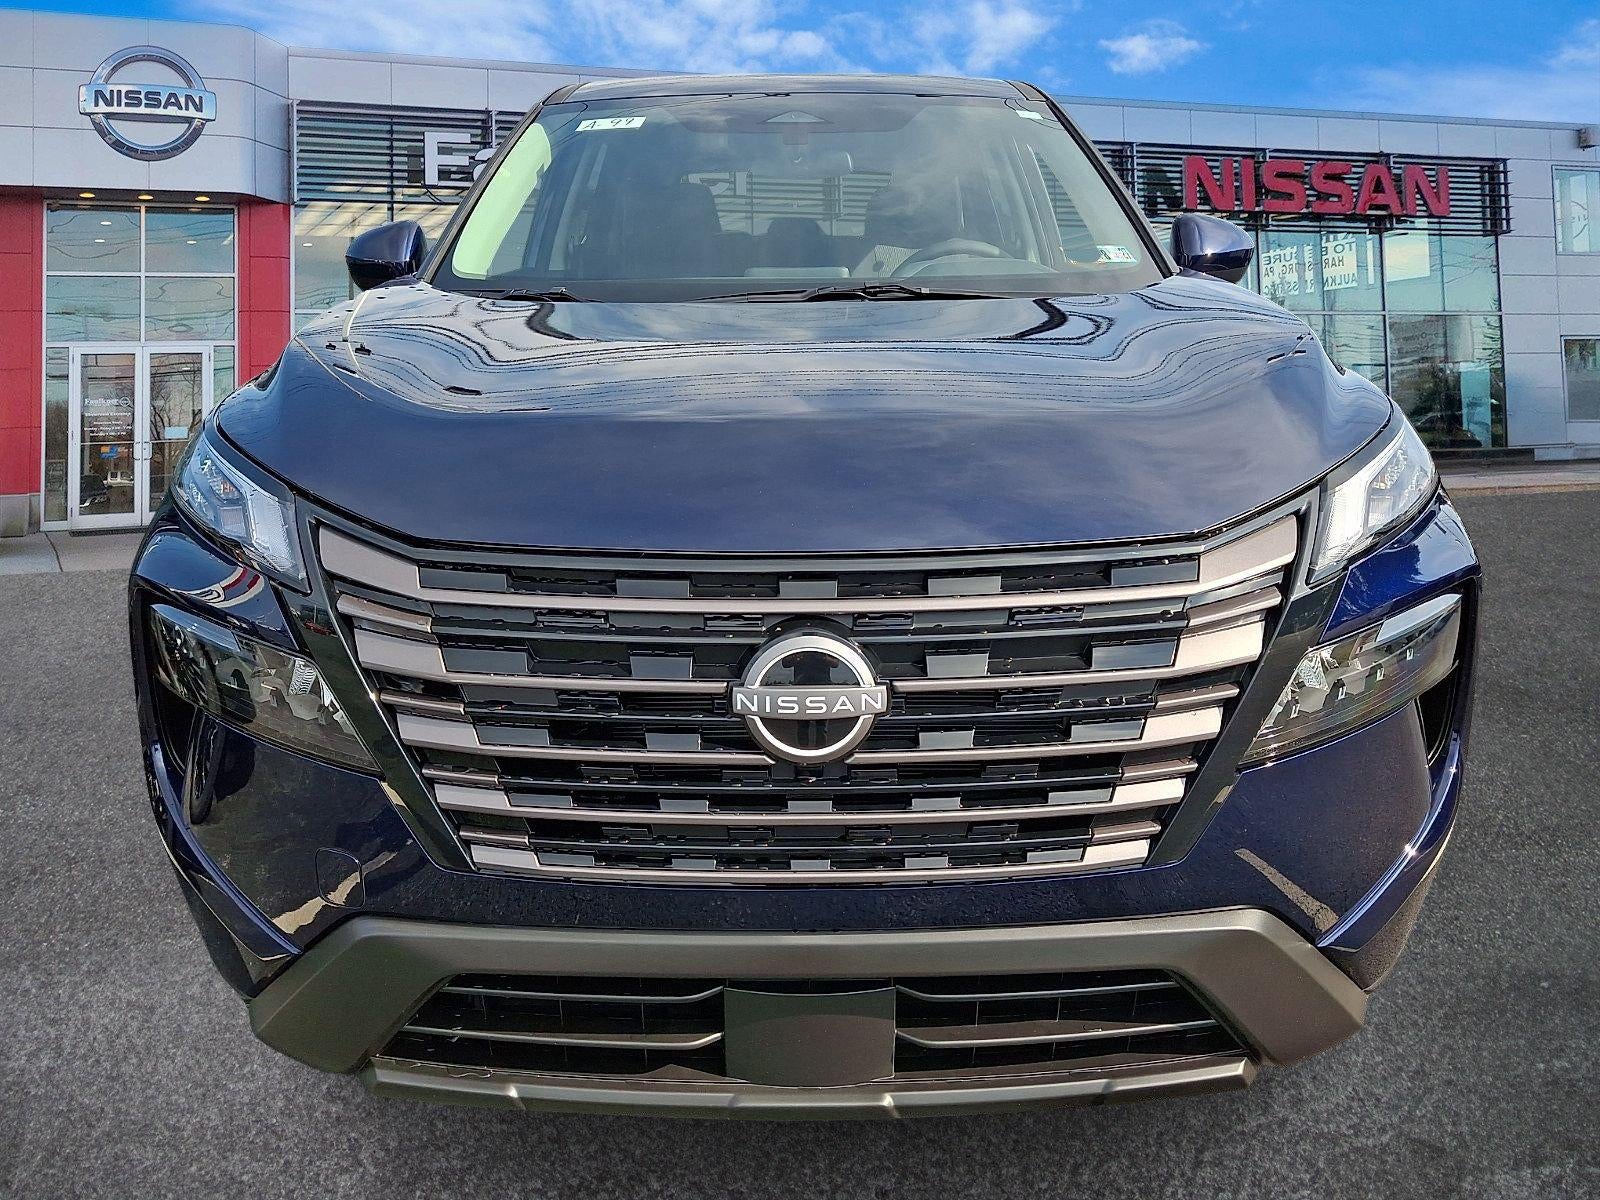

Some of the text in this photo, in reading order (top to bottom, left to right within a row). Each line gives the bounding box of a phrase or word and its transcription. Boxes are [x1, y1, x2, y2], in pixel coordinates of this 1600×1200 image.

[94, 89, 204, 113] NISSAN
[1182, 155, 1452, 217] NISSAN
[736, 692, 882, 714] NISSAN
